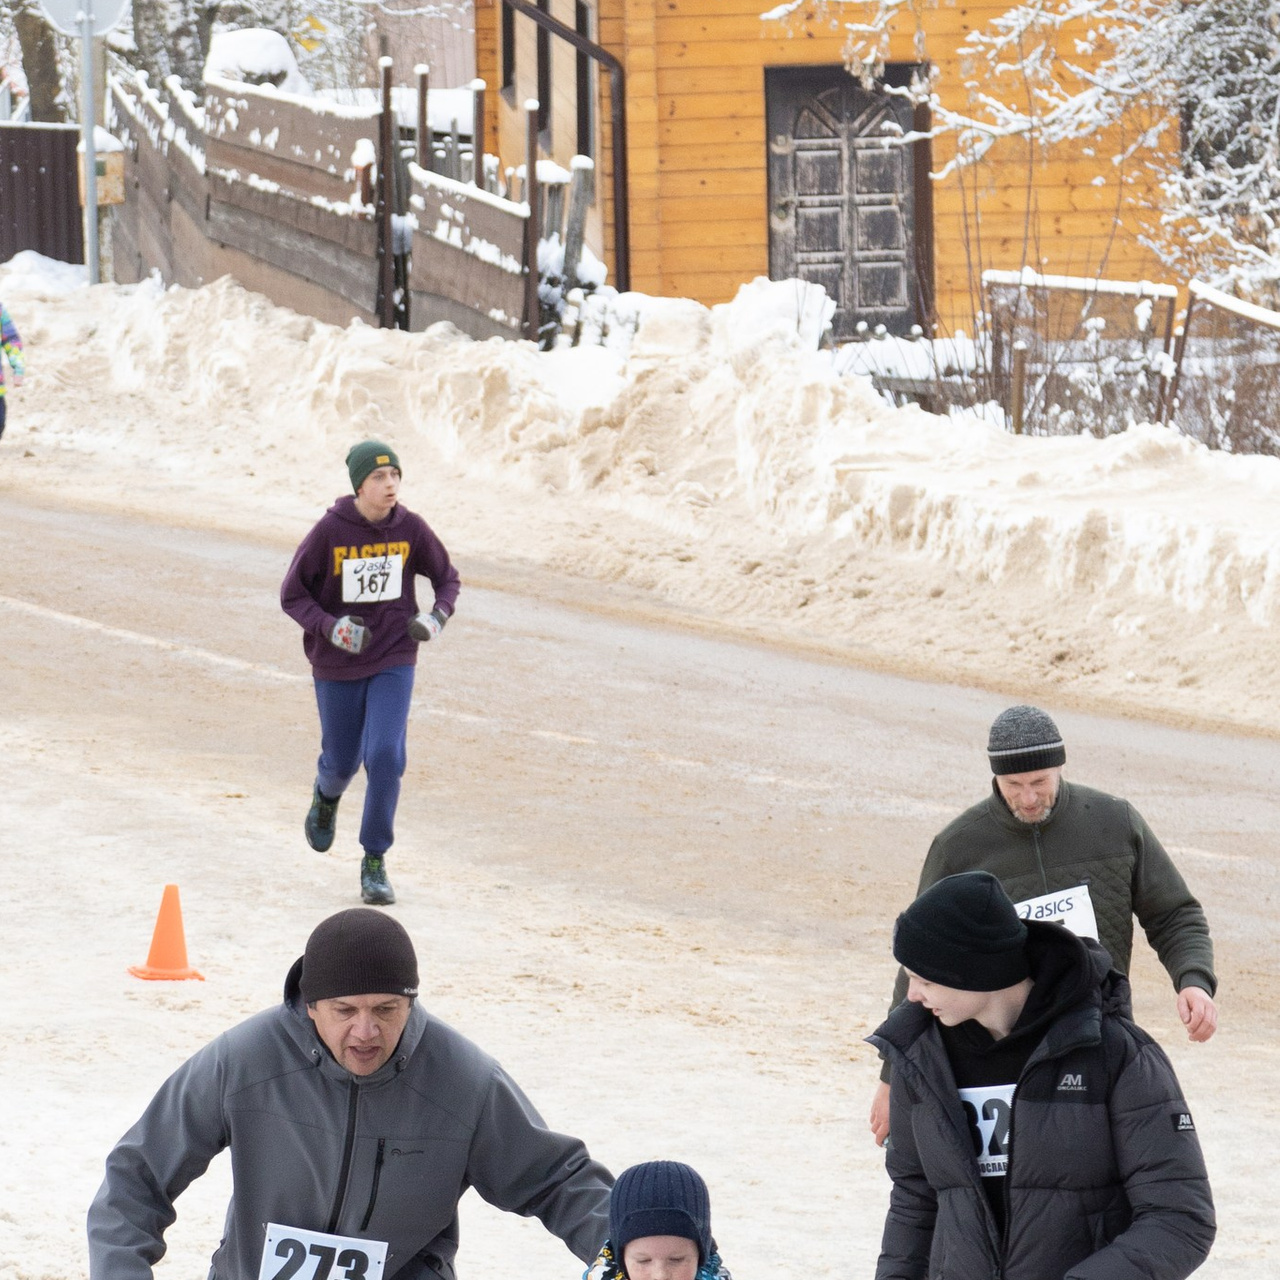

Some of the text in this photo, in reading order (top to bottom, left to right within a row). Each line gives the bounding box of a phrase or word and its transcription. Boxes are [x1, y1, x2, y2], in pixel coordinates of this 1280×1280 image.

[366, 560, 393, 571] asics
[357, 572, 390, 595] 167
[1034, 896, 1074, 919] asics
